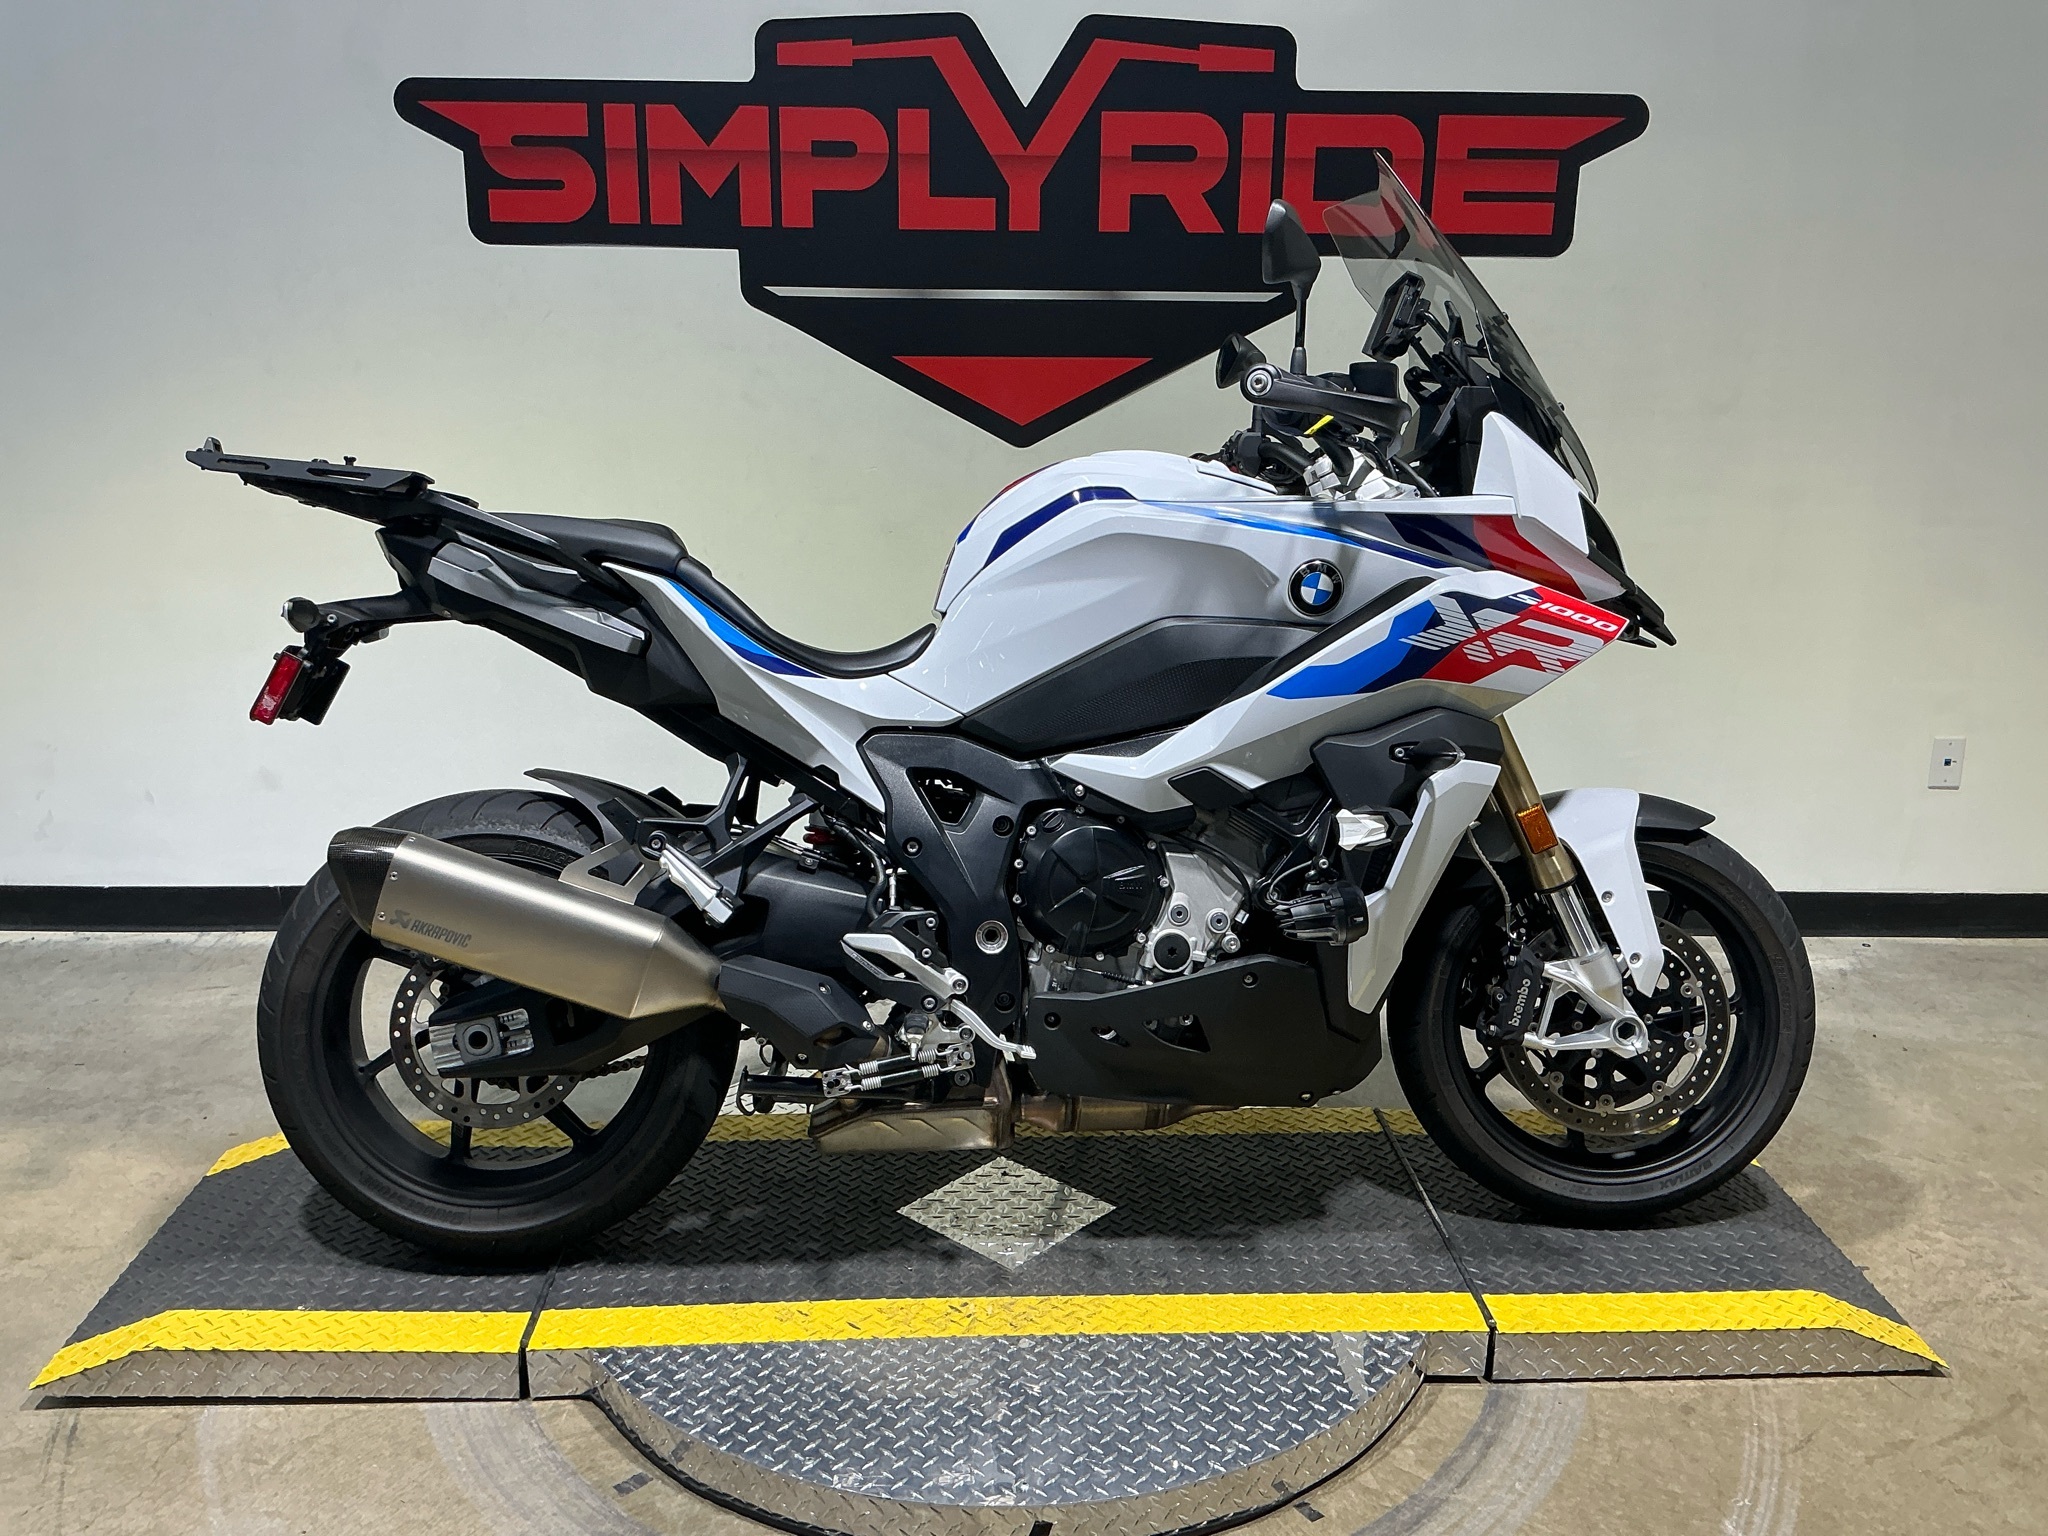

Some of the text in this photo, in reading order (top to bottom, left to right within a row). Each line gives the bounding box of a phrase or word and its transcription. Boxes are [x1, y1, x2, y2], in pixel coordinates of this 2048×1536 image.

[418, 36, 1627, 235] SIMPLYRIDE
[513, 839, 577, 866] BRIDGE
[1508, 978, 1531, 1027] brembo
